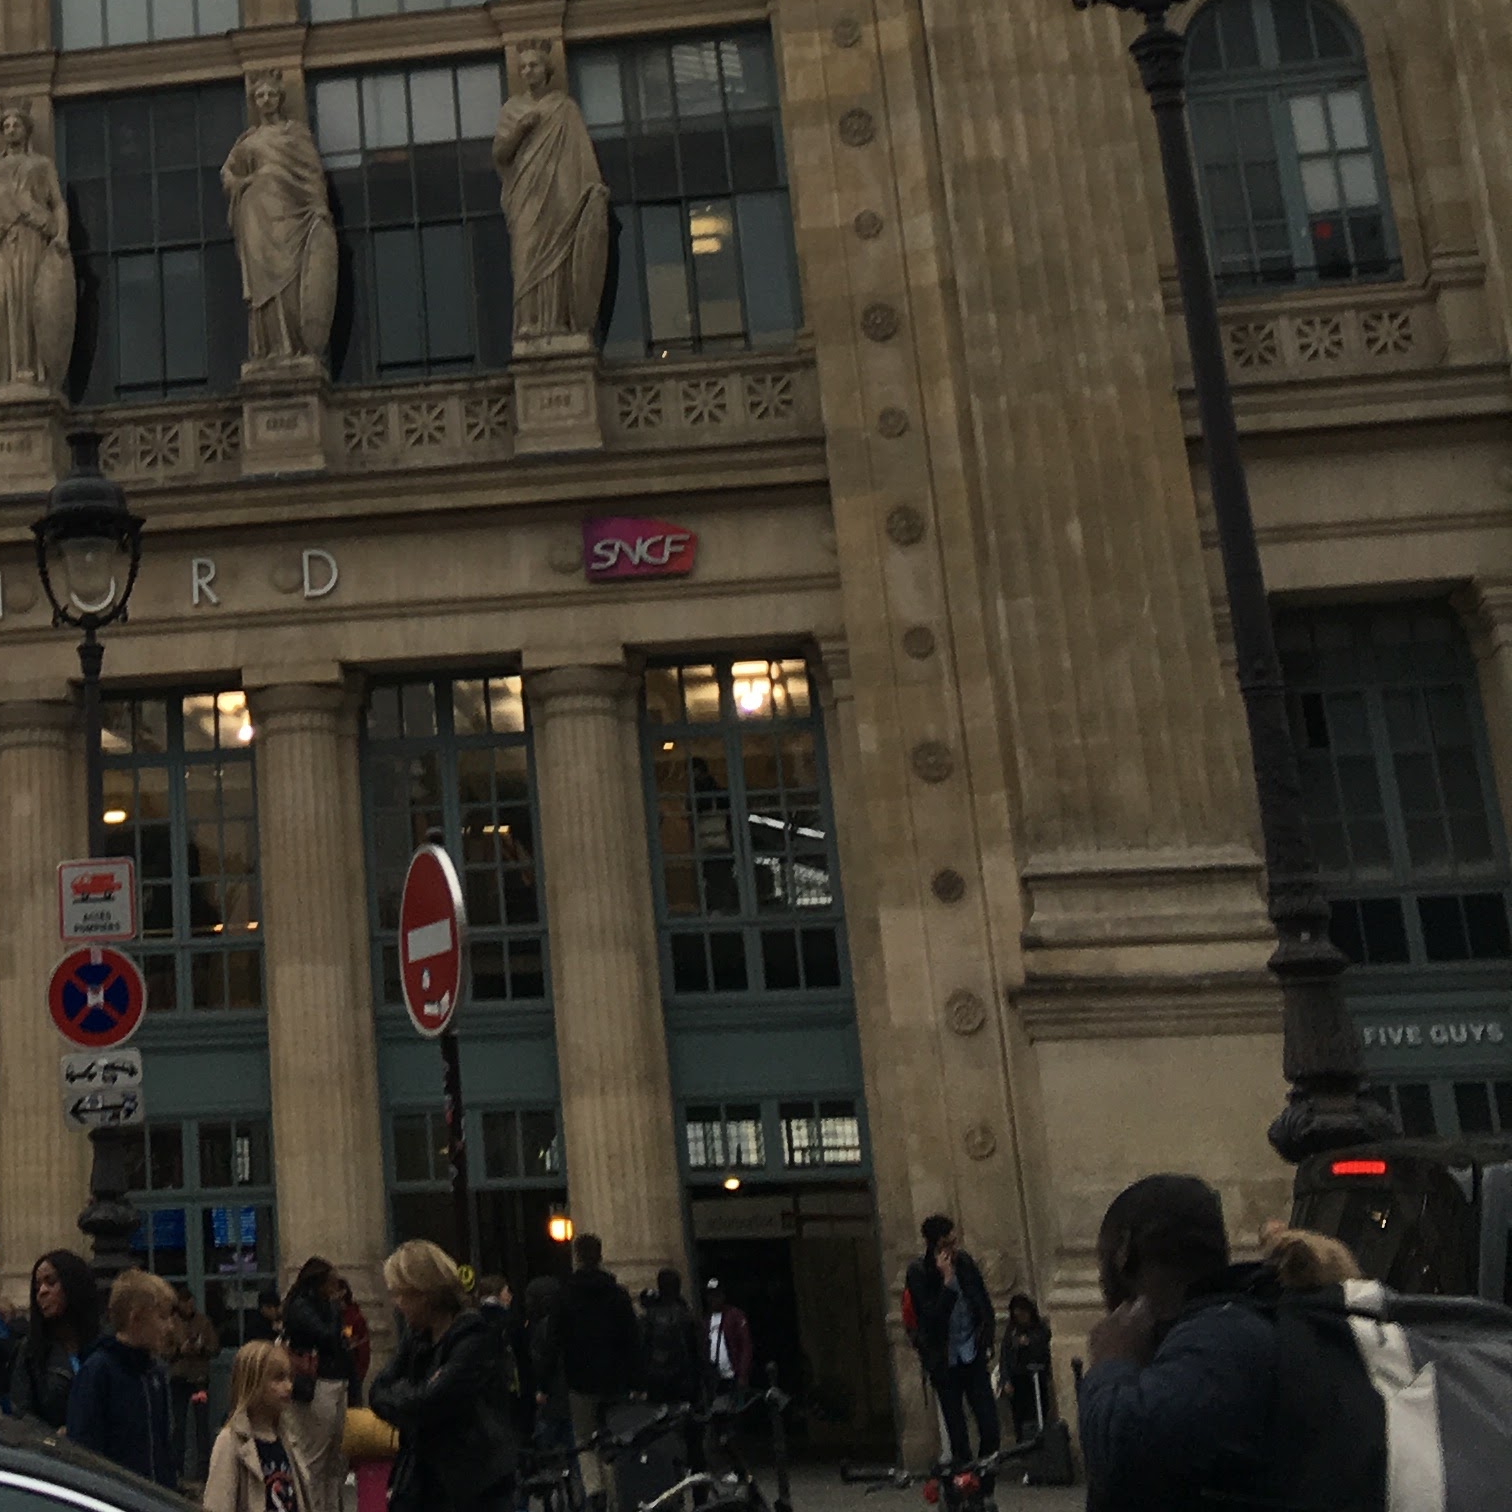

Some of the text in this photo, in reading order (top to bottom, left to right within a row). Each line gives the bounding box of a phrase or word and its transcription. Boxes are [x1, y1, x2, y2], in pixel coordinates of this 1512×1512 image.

[589, 533, 691, 570] SNCF
[1363, 1022, 1504, 1045] FIVE GUYS
